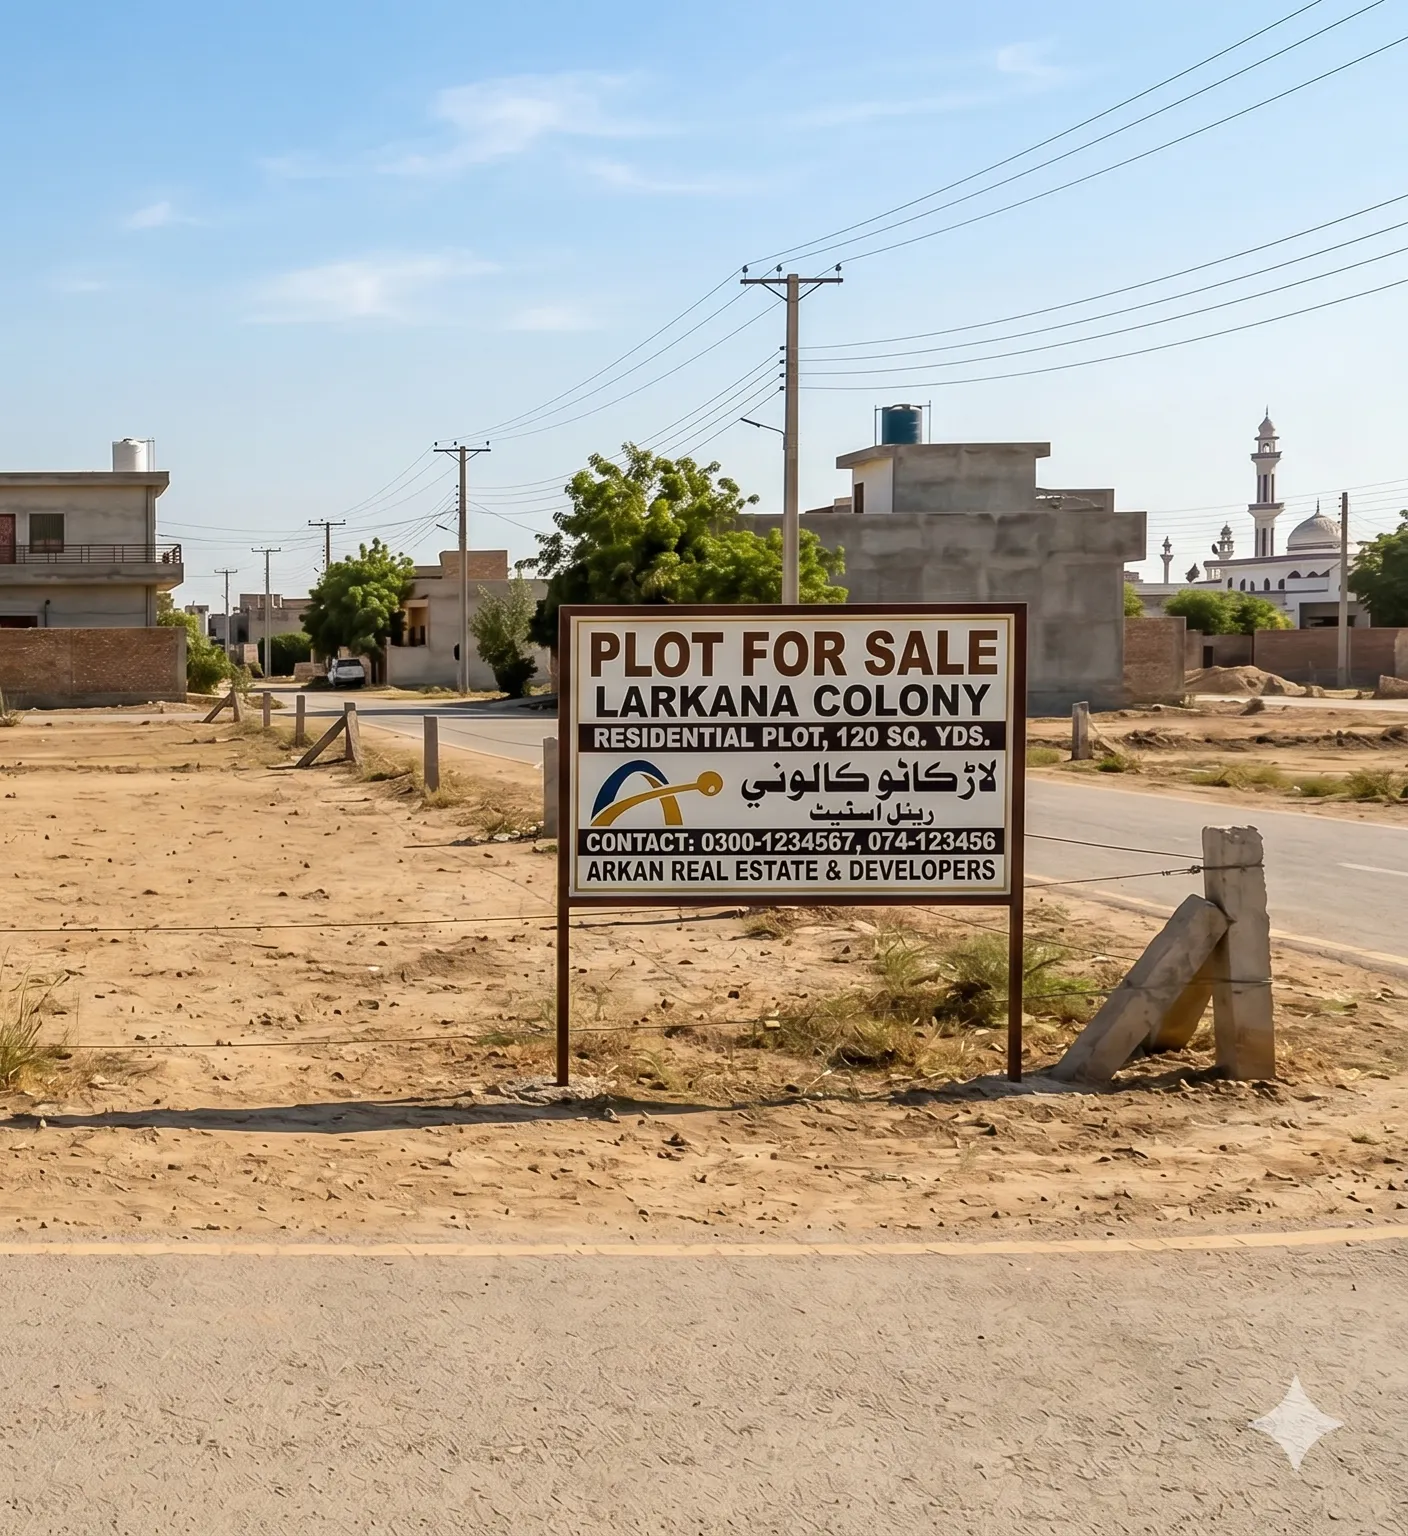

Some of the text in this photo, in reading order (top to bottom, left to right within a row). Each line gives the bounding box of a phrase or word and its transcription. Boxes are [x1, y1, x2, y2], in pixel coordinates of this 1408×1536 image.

[590, 629, 999, 678] PLOT FOR SALE
[595, 683, 992, 718] LARKANA COLONY
[594, 726, 991, 752] RESIDENTIAL PLOT, 120 SQ. YDS.
[586, 831, 996, 855] CONTACT: 0300-1234567, 074-123456
[586, 859, 996, 882] ARKAN REAL ESTATE & DEVELOPERS
